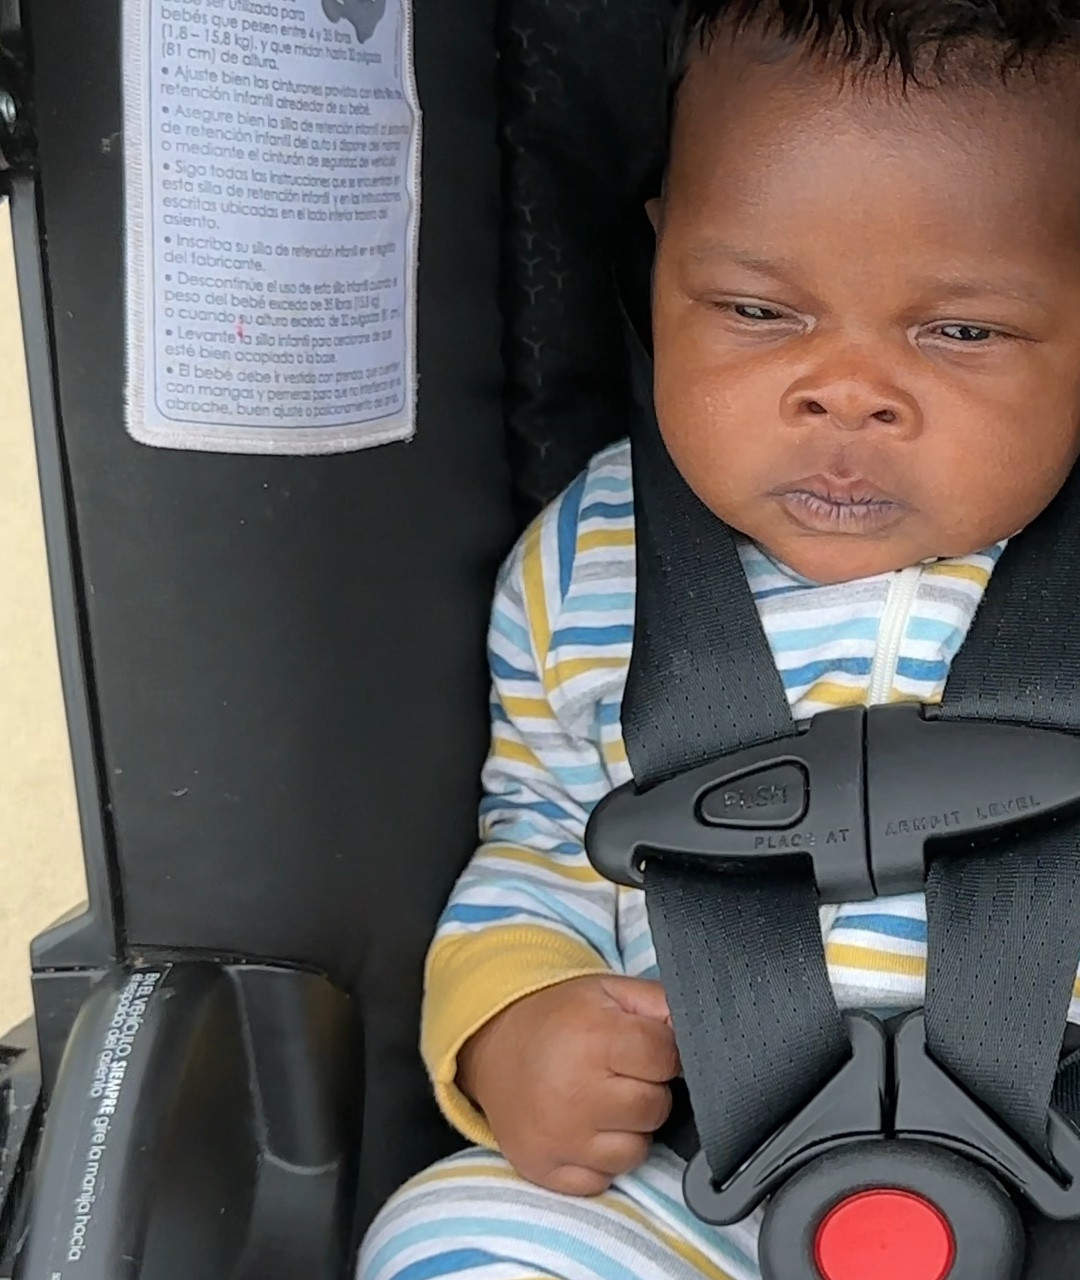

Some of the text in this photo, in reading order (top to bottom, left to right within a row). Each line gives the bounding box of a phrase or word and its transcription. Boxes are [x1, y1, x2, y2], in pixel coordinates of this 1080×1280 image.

[161, 5, 278, 32] bebés que pesen
[220, 50, 239, 64] de
[160, 82, 230, 100] retención
[210, 164, 248, 181] todas
[177, 326, 236, 344] Levante
[826, 828, 849, 844] AT
[97, 1060, 127, 1115] SIEMPRE
[93, 1116, 111, 1143] gire
[89, 1145, 106, 1160] la
[75, 1162, 99, 1213] manija
[68, 1215, 91, 1261] hacia
